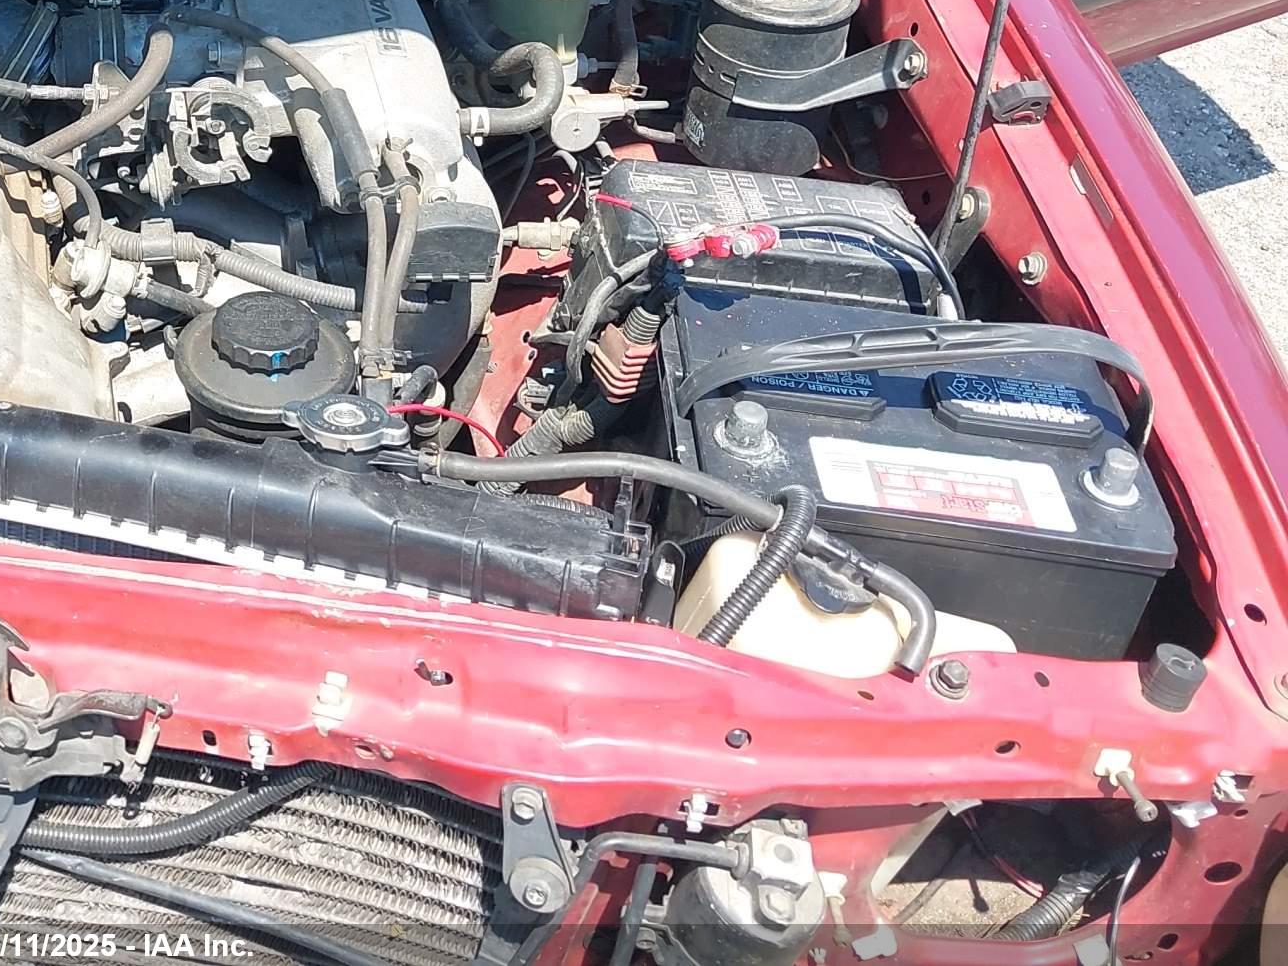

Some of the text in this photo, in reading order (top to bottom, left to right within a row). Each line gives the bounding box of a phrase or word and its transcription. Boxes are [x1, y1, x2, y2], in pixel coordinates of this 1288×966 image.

[377, 27, 402, 51] 16
[751, 375, 796, 388] POISON
[807, 382, 859, 396] DANGER
